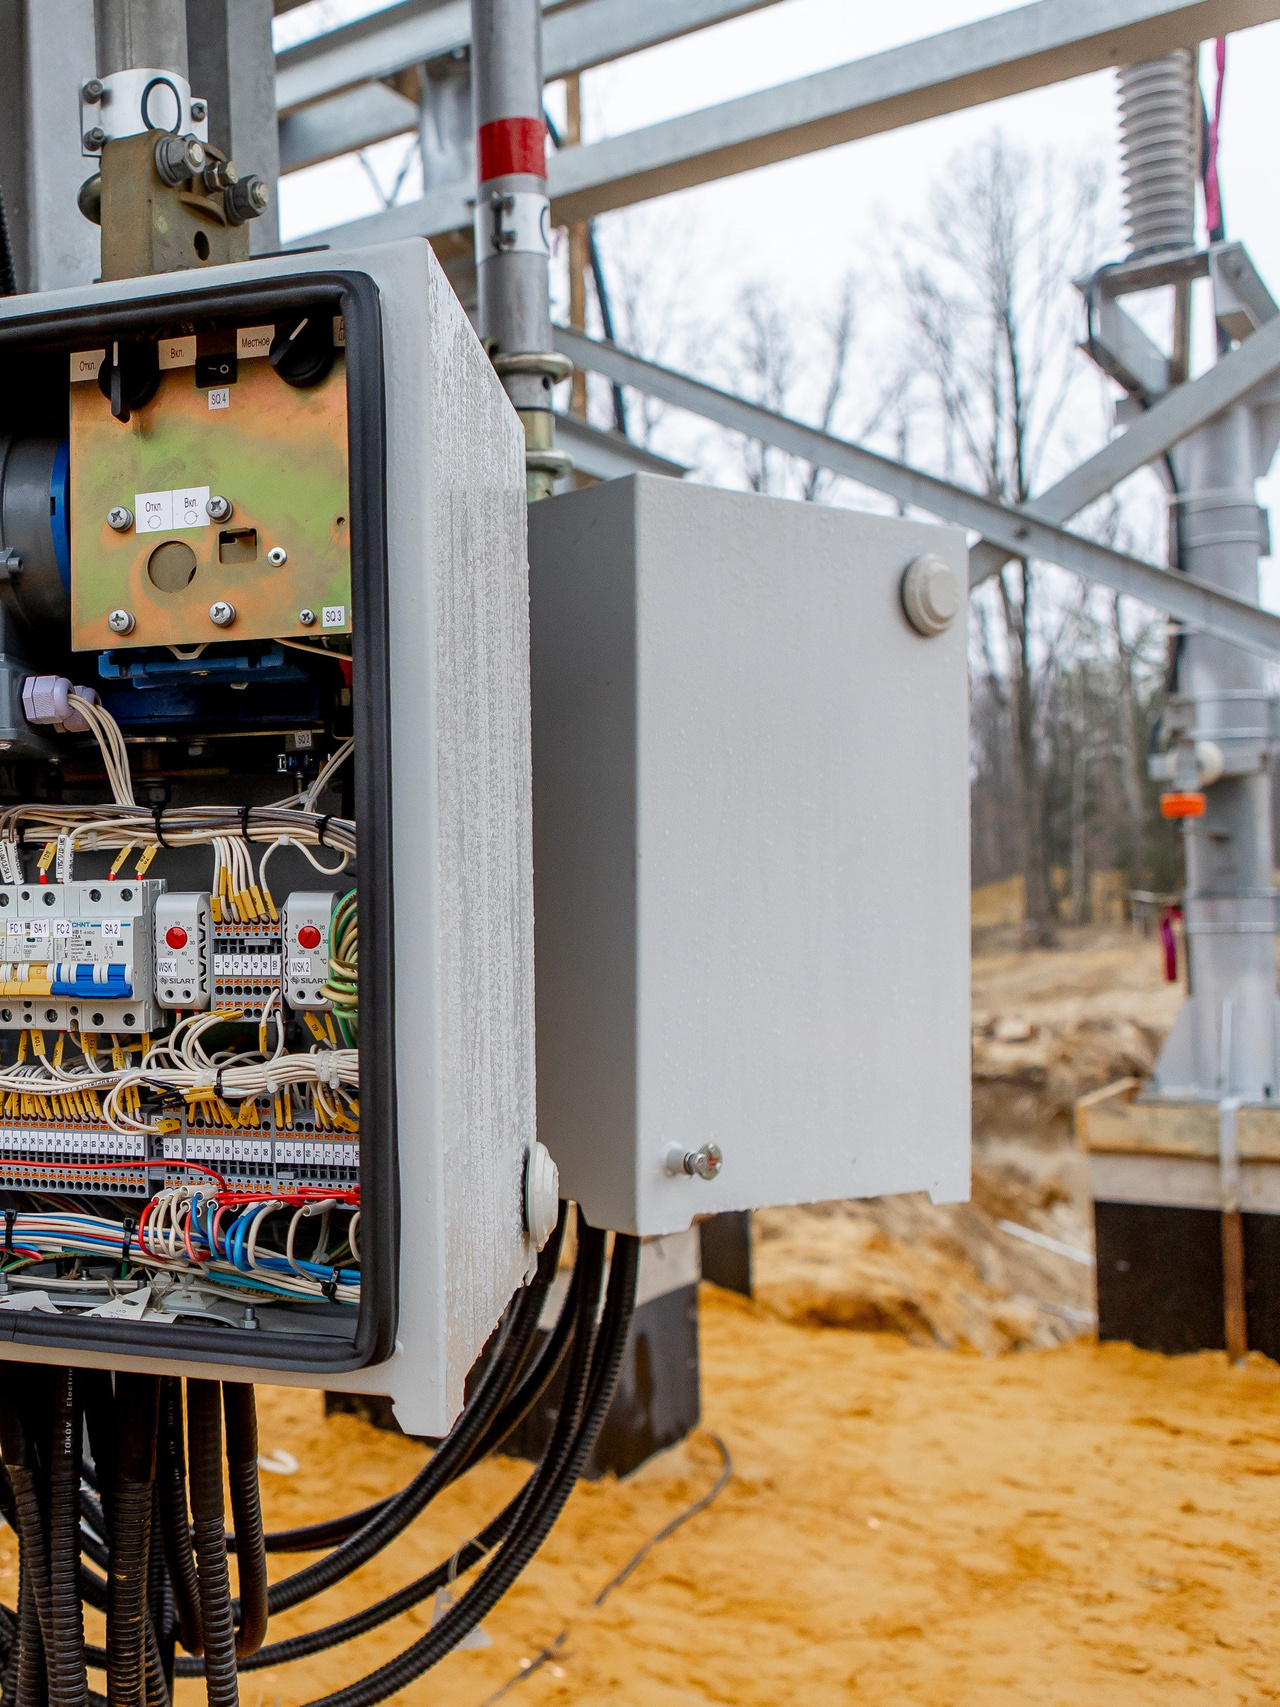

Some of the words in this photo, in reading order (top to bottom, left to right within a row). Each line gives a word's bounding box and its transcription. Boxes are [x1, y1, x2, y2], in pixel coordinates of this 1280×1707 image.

[241, 337, 270, 349] Местное
[170, 347, 185, 359] Вкл.
[79, 360, 97, 372] Откл.
[211, 393, 221, 405] SQ
[222, 392, 227, 403] 4
[145, 501, 163, 512] Откл.
[185, 497, 198, 508] Вкл.
[325, 611, 336, 622] SQ
[337, 610, 342, 621] 3
[10, 924, 19, 933] FC
[33, 924, 42, 934] SA
[56, 924, 65, 934] FC
[104, 924, 113, 934] SA
[158, 962, 172, 972] WSK
[292, 962, 305, 972] WSK
[225, 1146, 230, 1154] 60
[254, 1148, 259, 1156] 64
[263, 1148, 268, 1156] 66
[286, 1149, 291, 1157] 67
[64, 1421, 72, 1454] TOKOV
